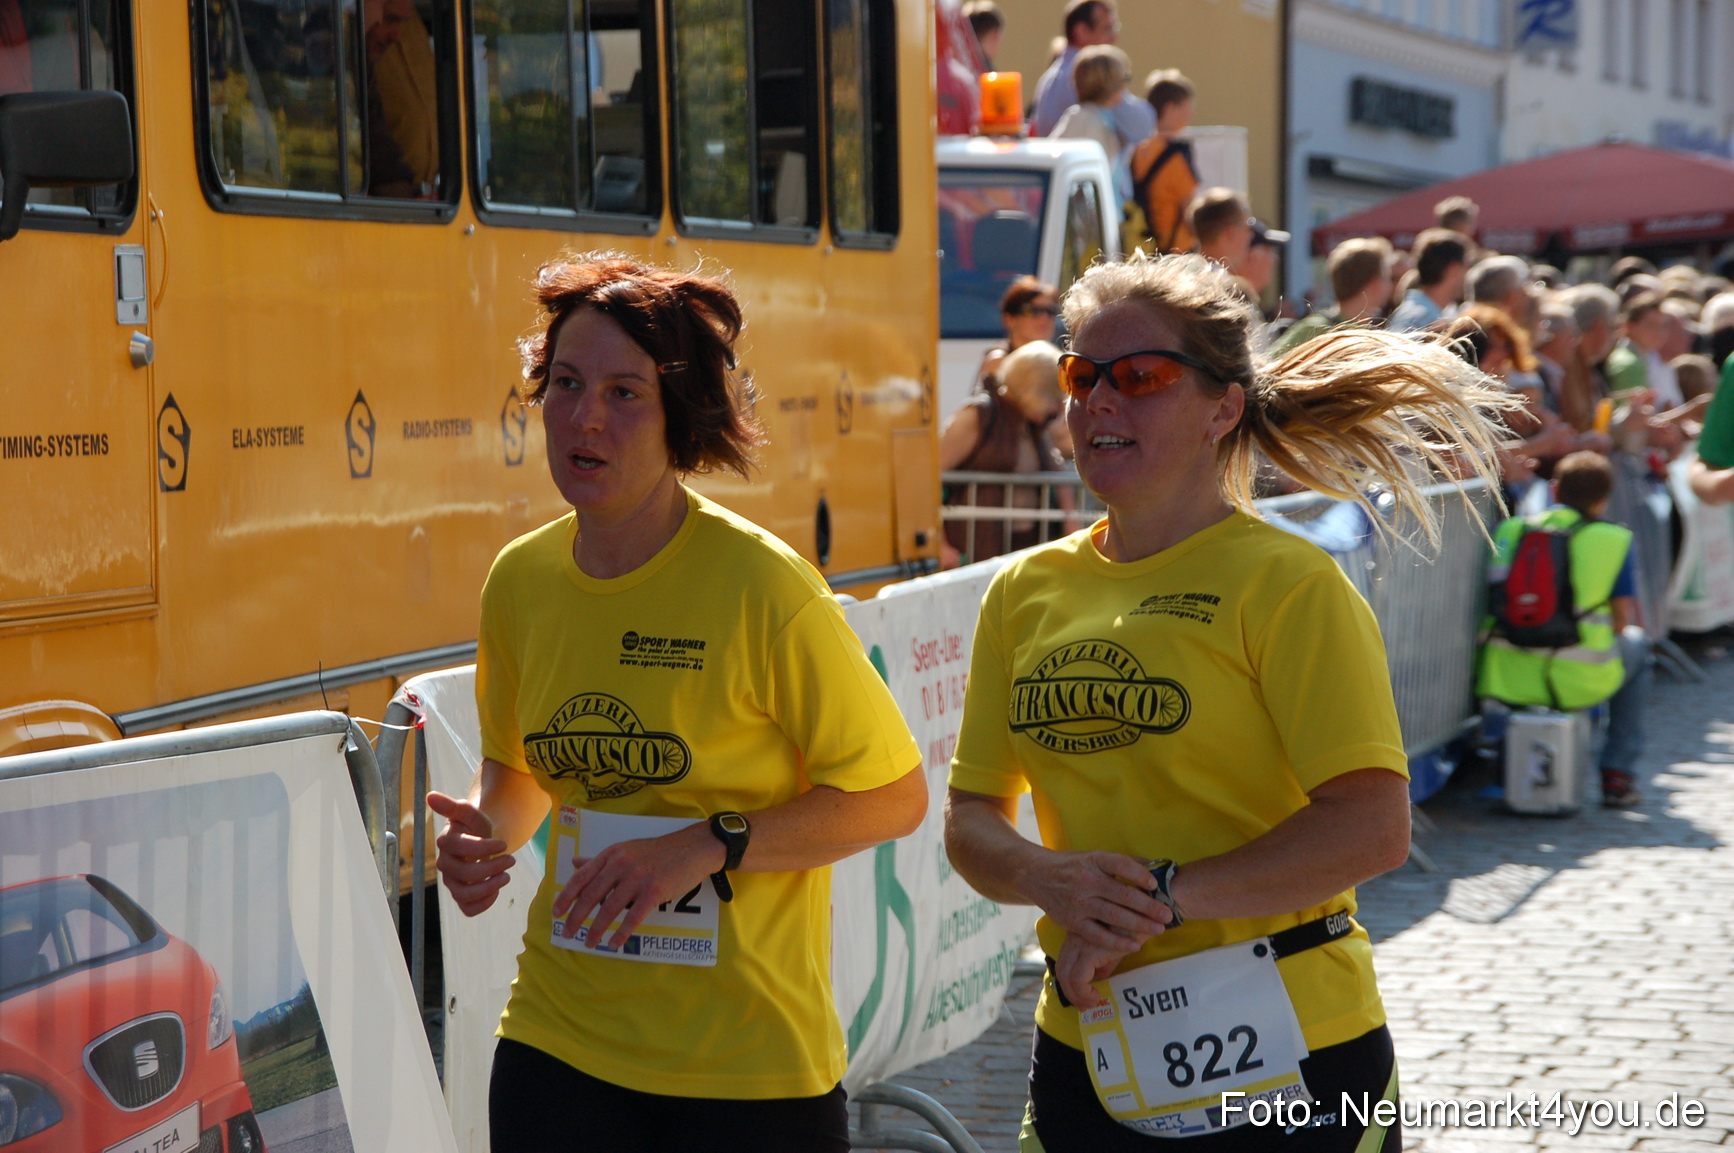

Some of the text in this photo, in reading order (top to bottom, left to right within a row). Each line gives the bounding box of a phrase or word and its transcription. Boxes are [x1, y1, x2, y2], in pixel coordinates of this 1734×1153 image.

[232, 425, 305, 449] ELA-SYSTEME
[403, 418, 473, 440] RADIO-SYSTEMS
[1182, 592, 1221, 606] WAGNER
[639, 636, 706, 651] SPORT WAGNER
[619, 658, 703, 671] www.sport-wagner.de
[1036, 643, 1139, 681] PIZZERIA
[1015, 681, 1159, 724] FRANCESCO
[550, 697, 638, 735] PIZZERIA
[534, 736, 661, 776] FRANCESCO
[642, 935, 713, 954] PFLEIDERER
[1122, 985, 1189, 1020] Sven
[1096, 1047, 1109, 1073] A
[1162, 1024, 1264, 1089] 822
